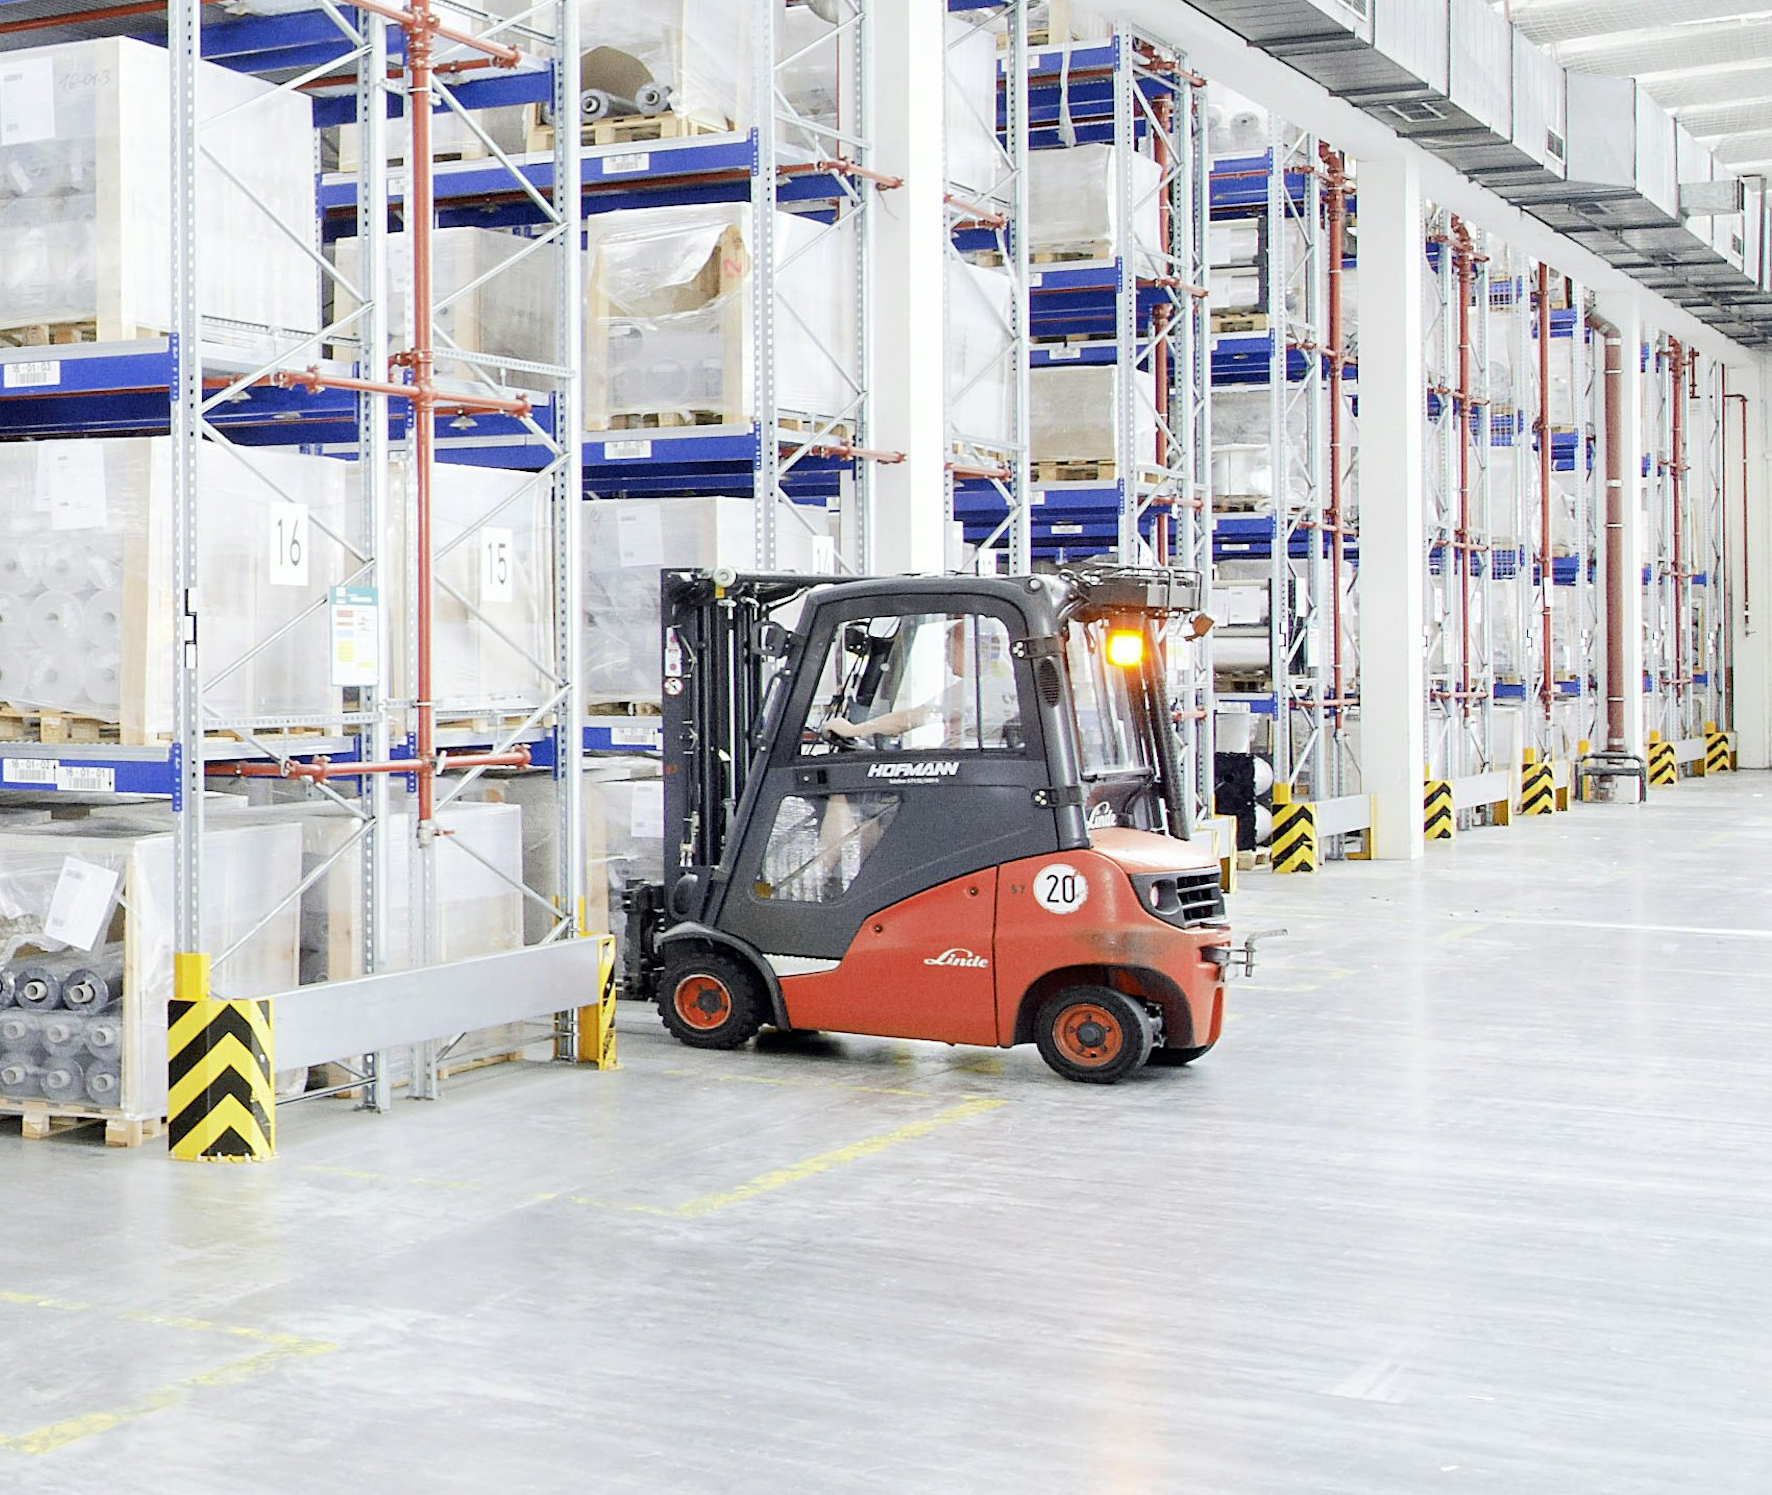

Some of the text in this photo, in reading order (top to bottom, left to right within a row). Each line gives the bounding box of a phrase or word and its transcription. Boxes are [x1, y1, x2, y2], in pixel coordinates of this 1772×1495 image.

[277, 518, 301, 567] 16
[488, 542, 507, 585] 15
[867, 762, 959, 777] HOFMANN
[1087, 801, 1117, 828] Linde
[1046, 874, 1075, 903] 20
[923, 948, 988, 968] Linde
